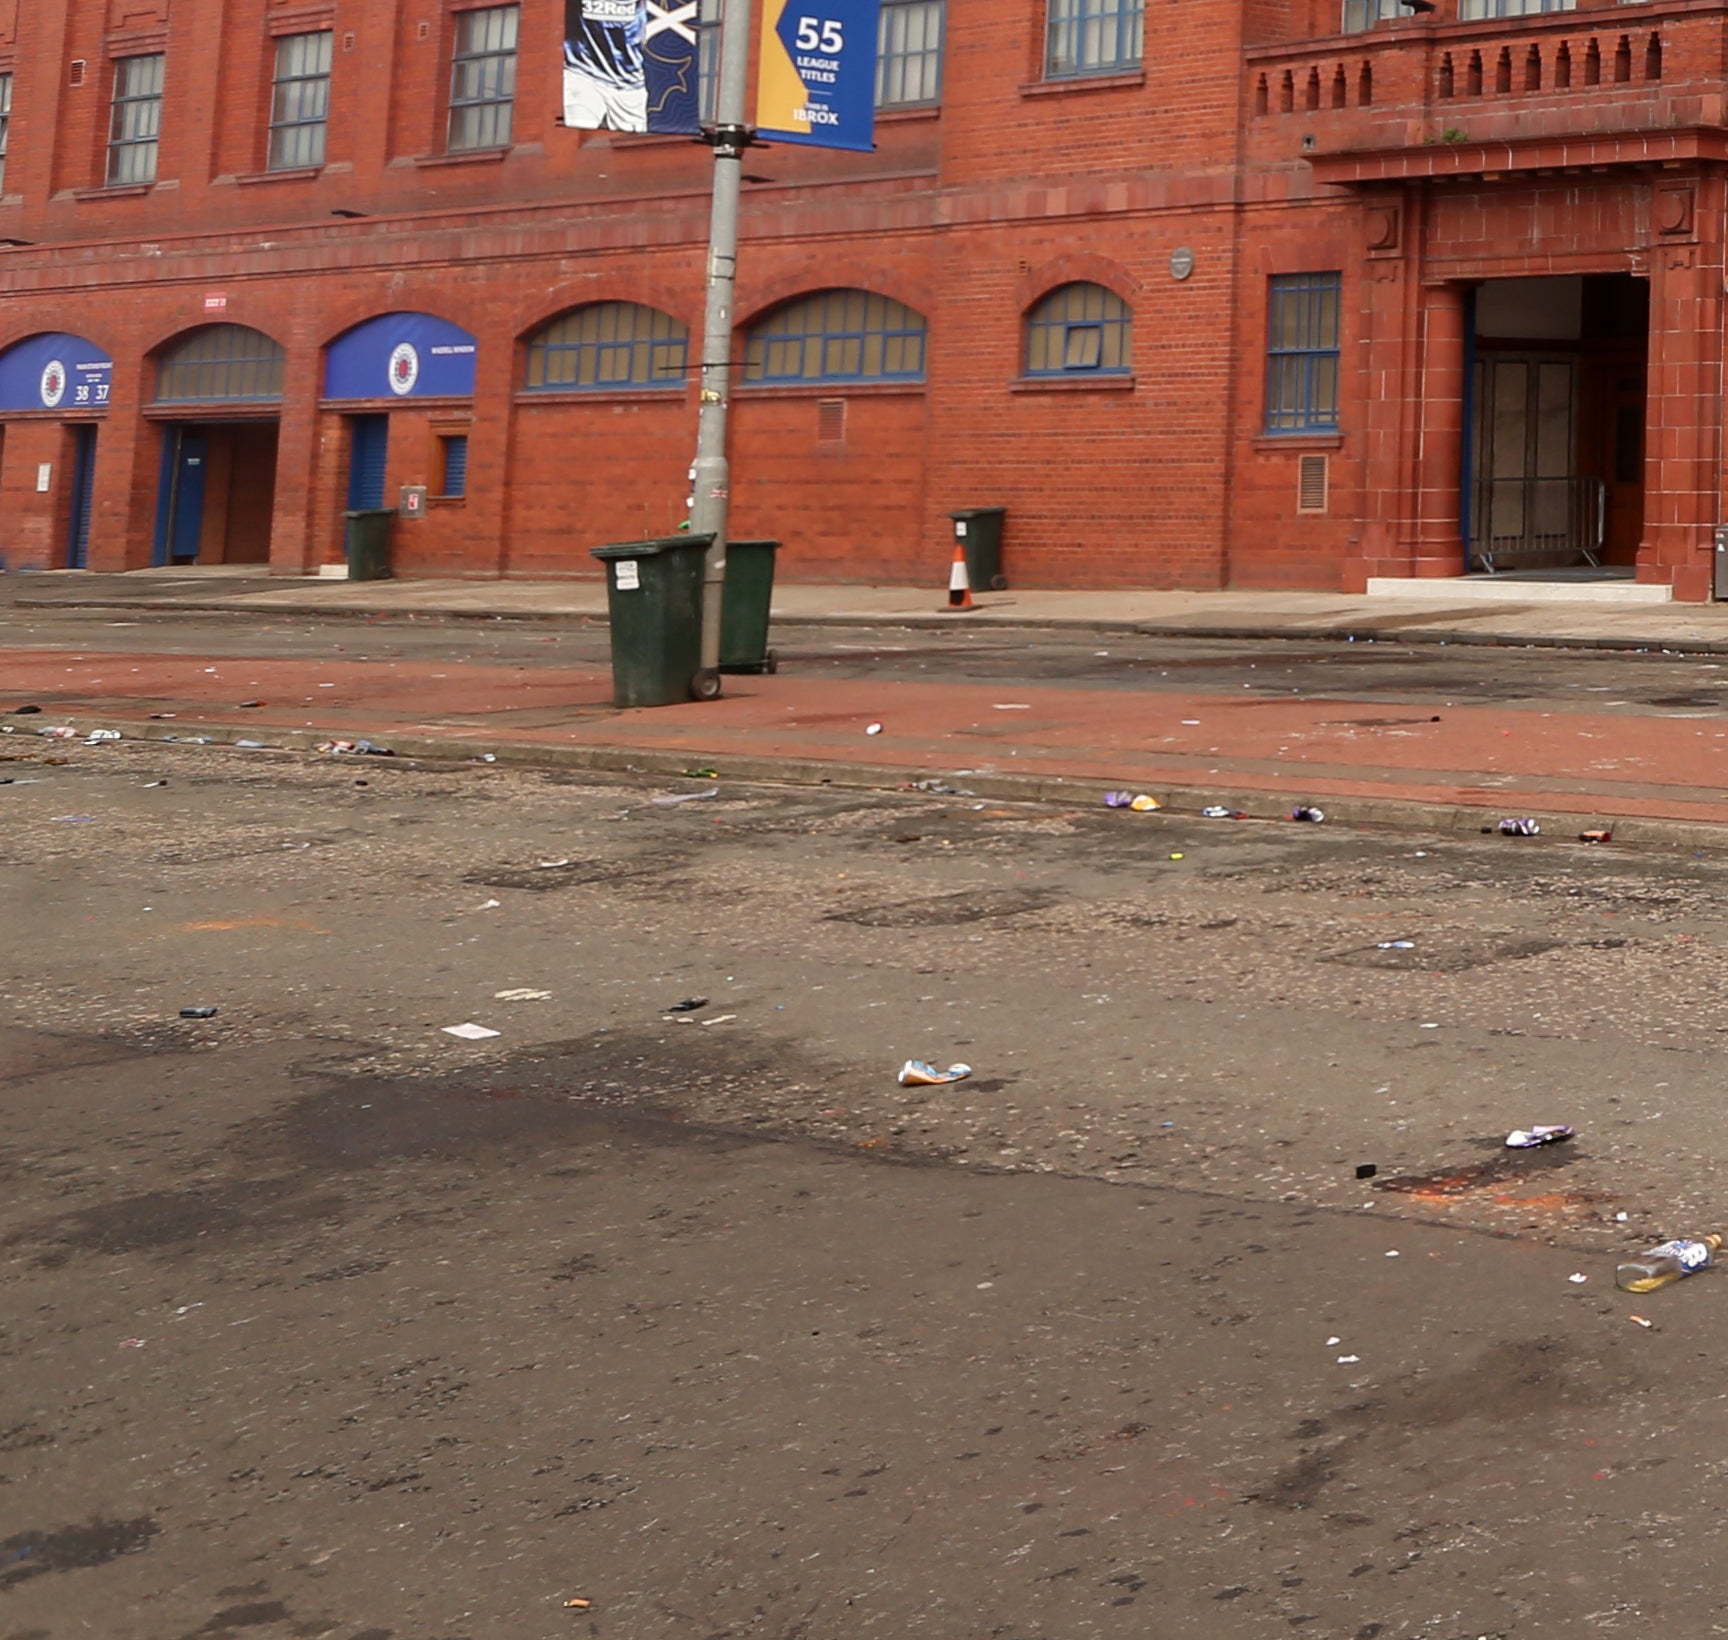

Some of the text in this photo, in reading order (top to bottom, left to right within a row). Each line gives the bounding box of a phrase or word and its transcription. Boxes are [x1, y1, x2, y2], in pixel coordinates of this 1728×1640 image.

[581, 0, 635, 14] 32Red
[796, 17, 843, 53] 55
[797, 57, 840, 71] LEAGUE
[800, 71, 836, 82] TITLES
[793, 109, 839, 125] IBROX
[76, 385, 110, 400] 38 37
